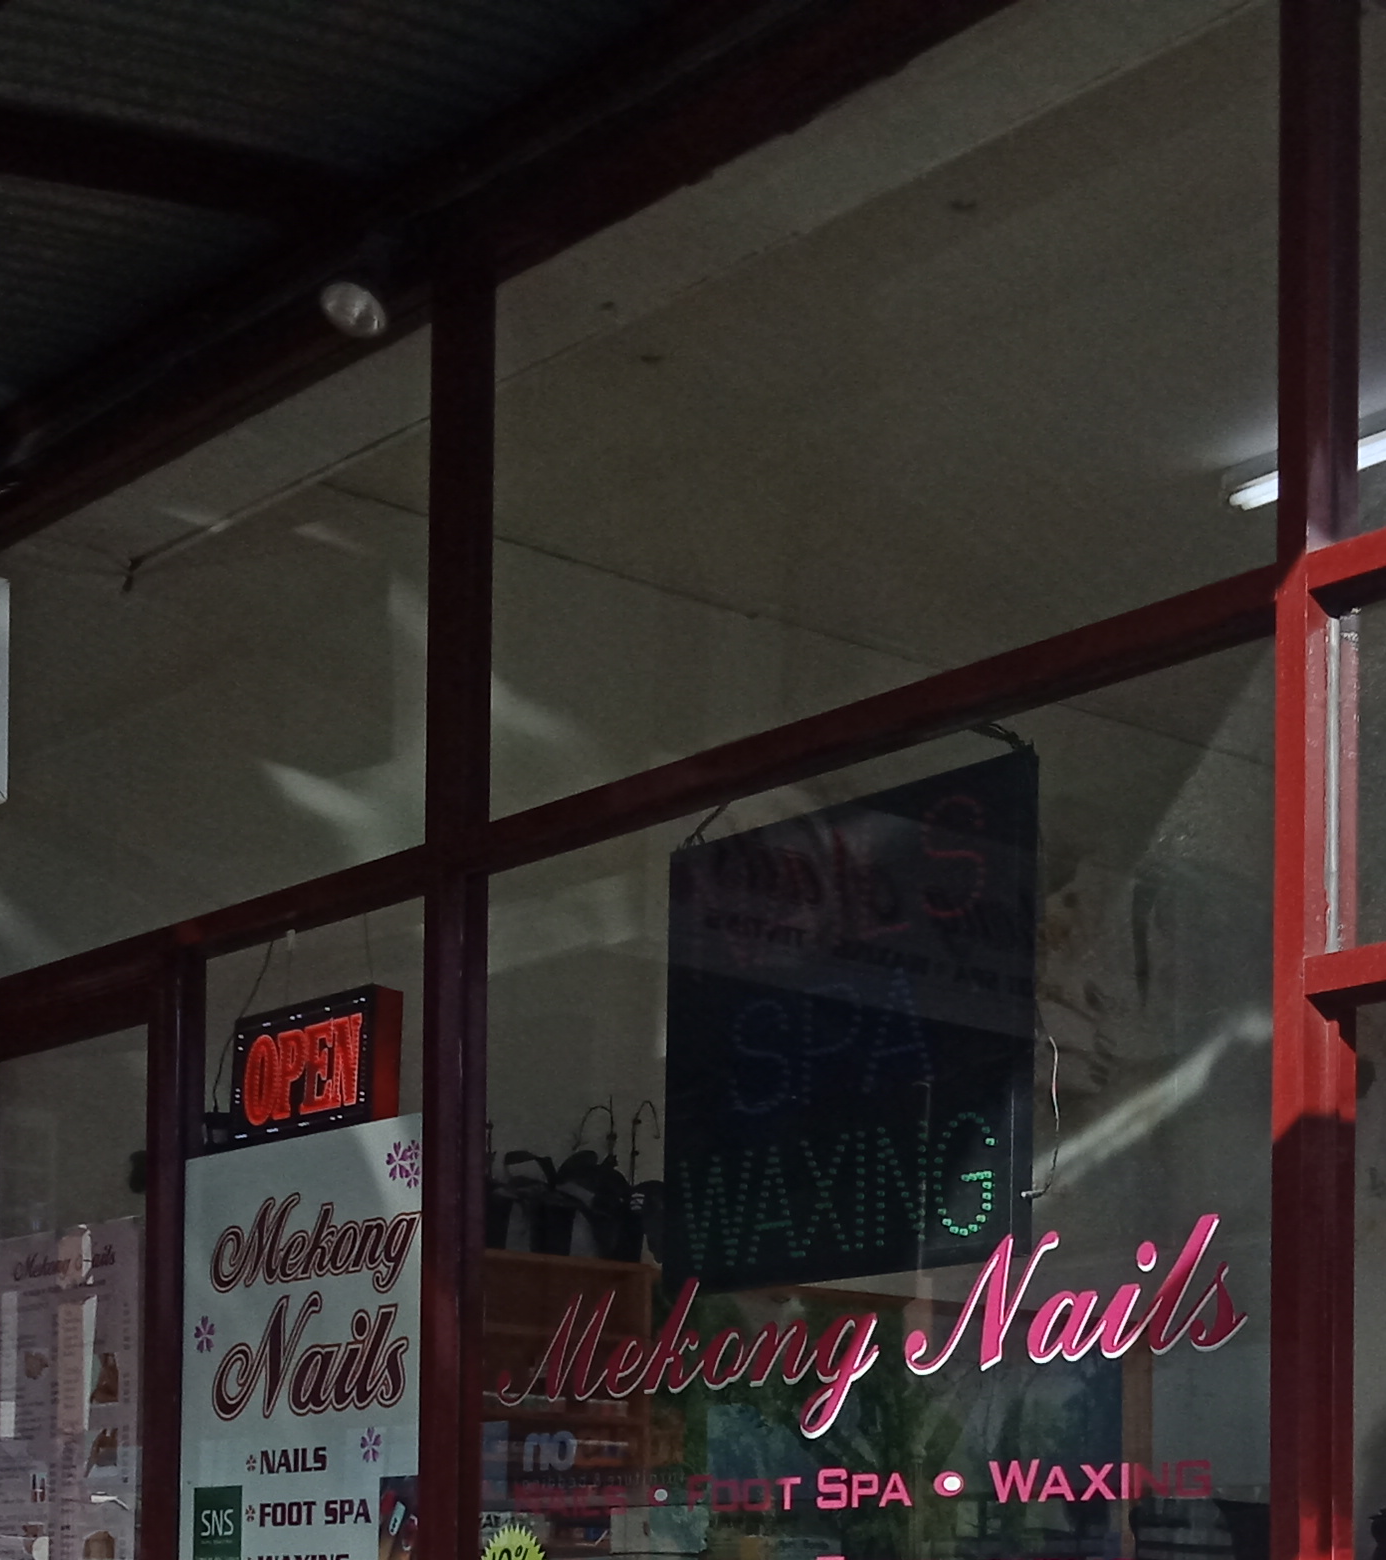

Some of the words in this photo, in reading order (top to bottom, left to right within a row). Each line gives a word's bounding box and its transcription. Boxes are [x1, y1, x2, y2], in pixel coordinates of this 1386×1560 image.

[243, 1012, 364, 1127] OPEN
[680, 1112, 996, 1270] WAXING
[210, 1192, 421, 1294] Mekong
[212, 1290, 409, 1422] Nails
[497, 1276, 880, 1439] Mekong
[904, 1213, 1248, 1375] Nails
[259, 1446, 327, 1475] NAILS
[816, 1467, 912, 1510] SPA
[988, 1459, 1212, 1504] WAXING
[201, 1508, 234, 1537] SNS
[258, 1501, 319, 1529] FOOT
[325, 1498, 372, 1526] SPA
